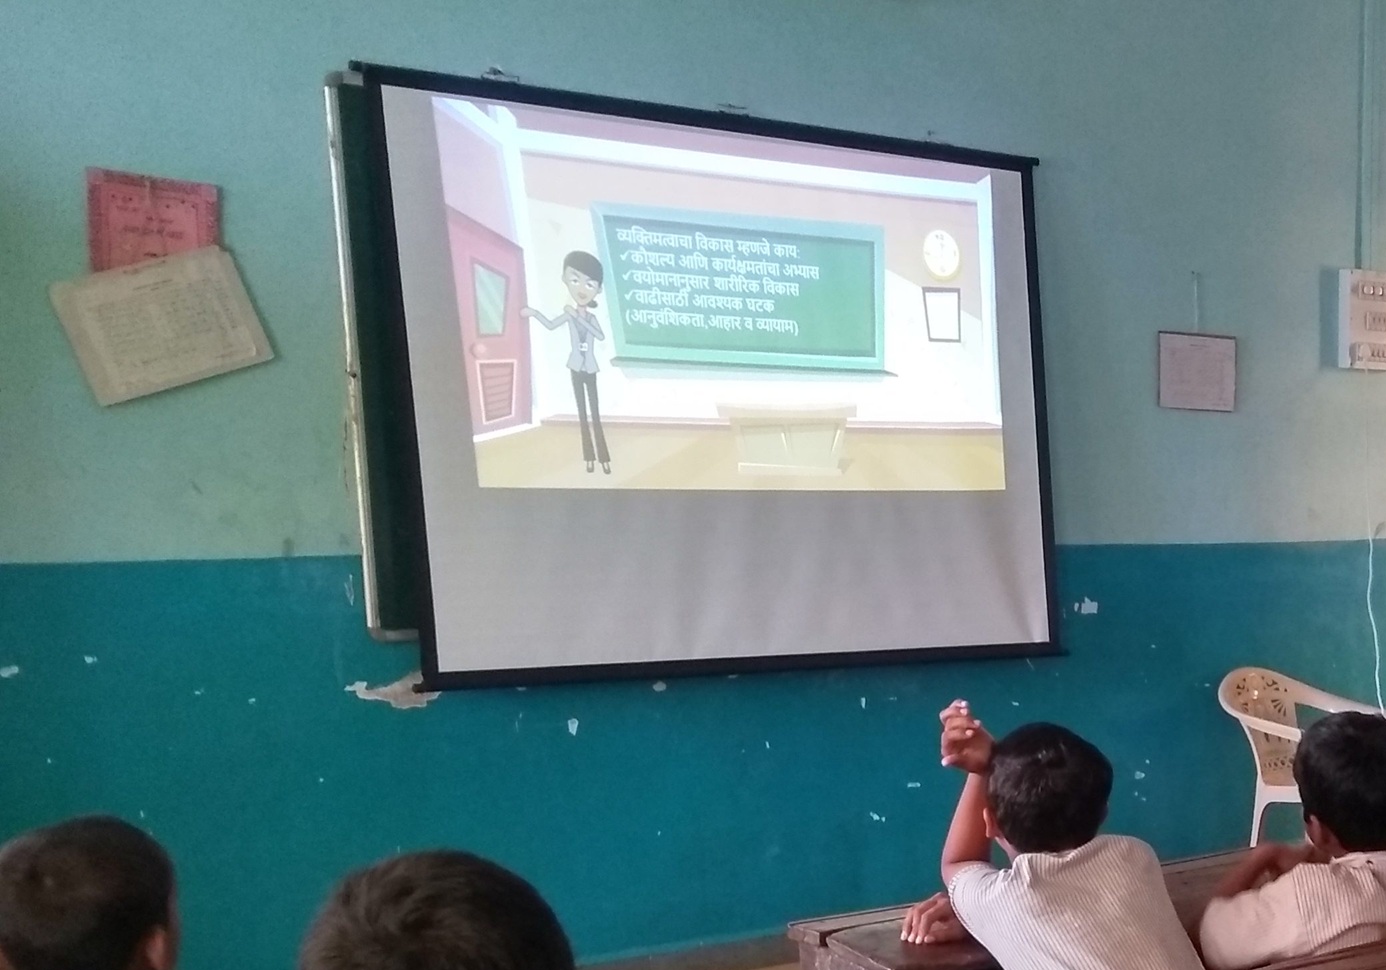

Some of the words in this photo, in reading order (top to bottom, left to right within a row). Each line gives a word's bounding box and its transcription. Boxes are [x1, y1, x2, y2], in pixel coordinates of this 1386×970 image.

[695, 231, 734, 253] विकास
[735, 237, 771, 257] म्हणजे
[679, 251, 709, 270] आणि
[782, 263, 820, 280] अभ्यास
[632, 266, 711, 292] वयोमानानुसार
[713, 273, 760, 293] शारीरिक
[762, 276, 800, 297] विकास
[633, 286, 689, 307] वाढीसाठी
[692, 293, 743, 311] आवश्यक
[745, 297, 776, 313] घटक
